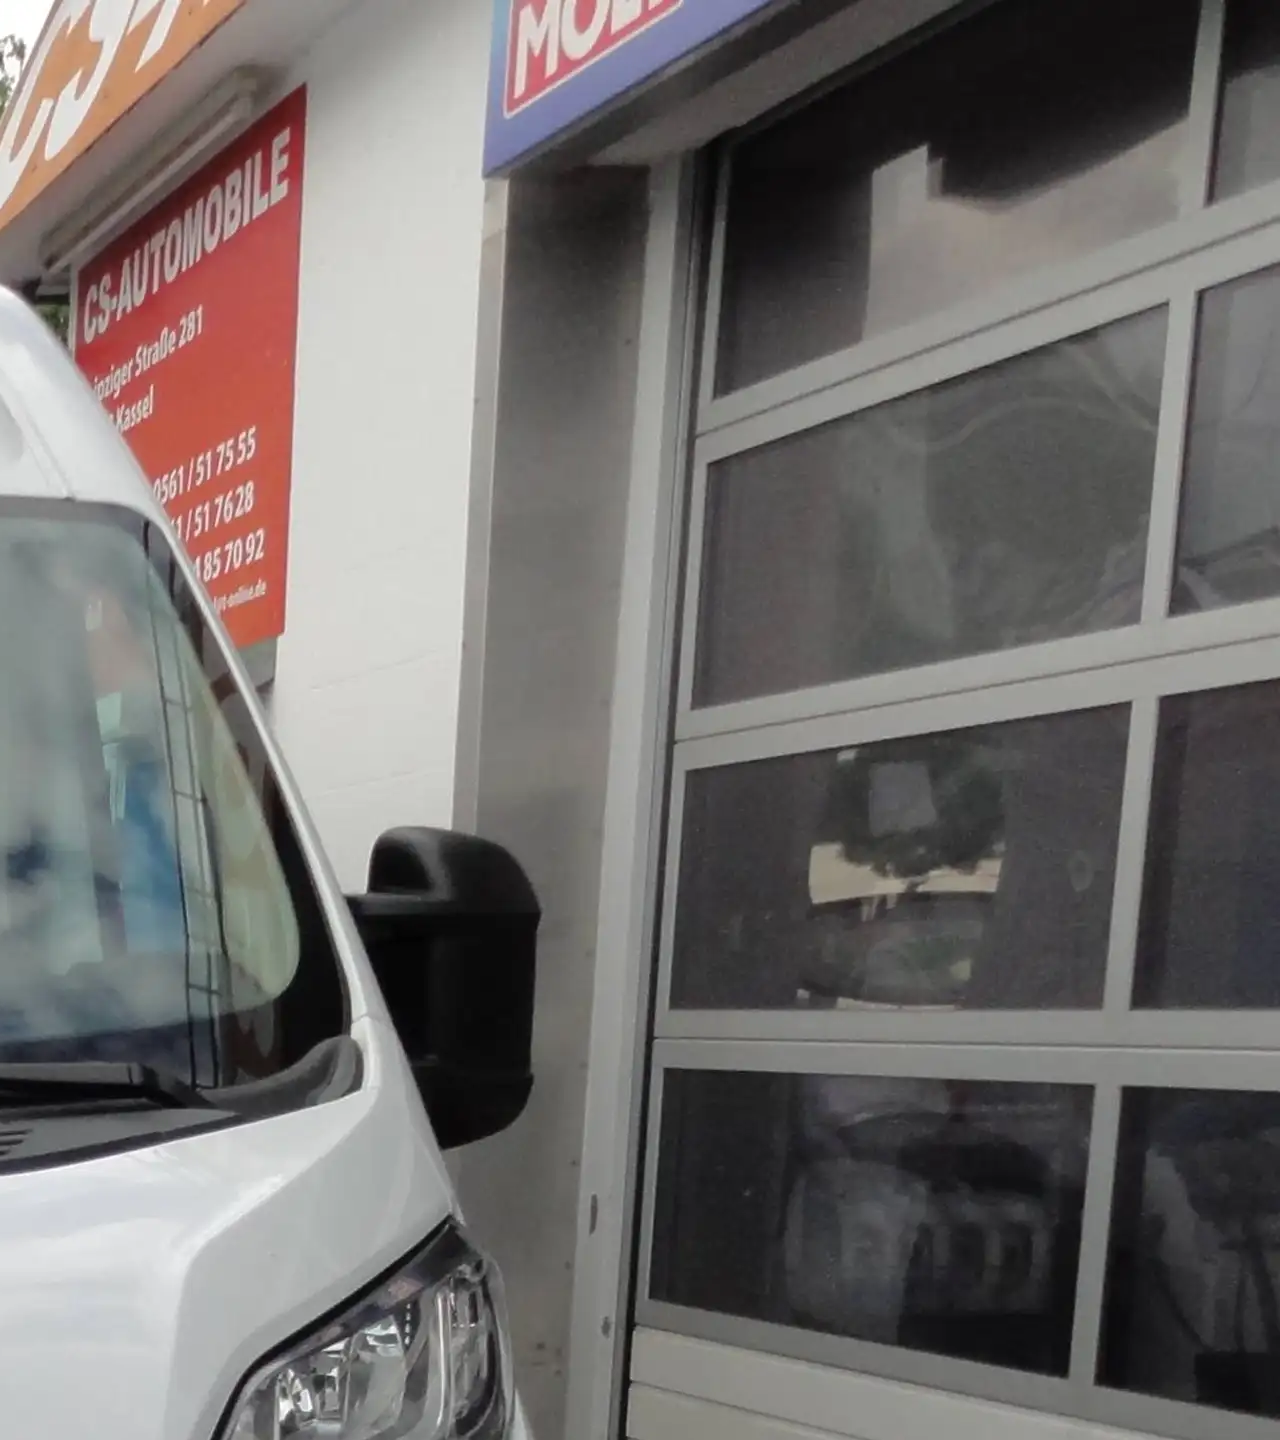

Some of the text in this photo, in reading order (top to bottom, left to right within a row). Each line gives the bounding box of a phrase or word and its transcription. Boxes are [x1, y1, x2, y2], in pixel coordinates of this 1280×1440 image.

[83, 129, 290, 344] CS-AUTOMOBILE
[178, 303, 203, 348] 281
[115, 383, 154, 433] Kassel
